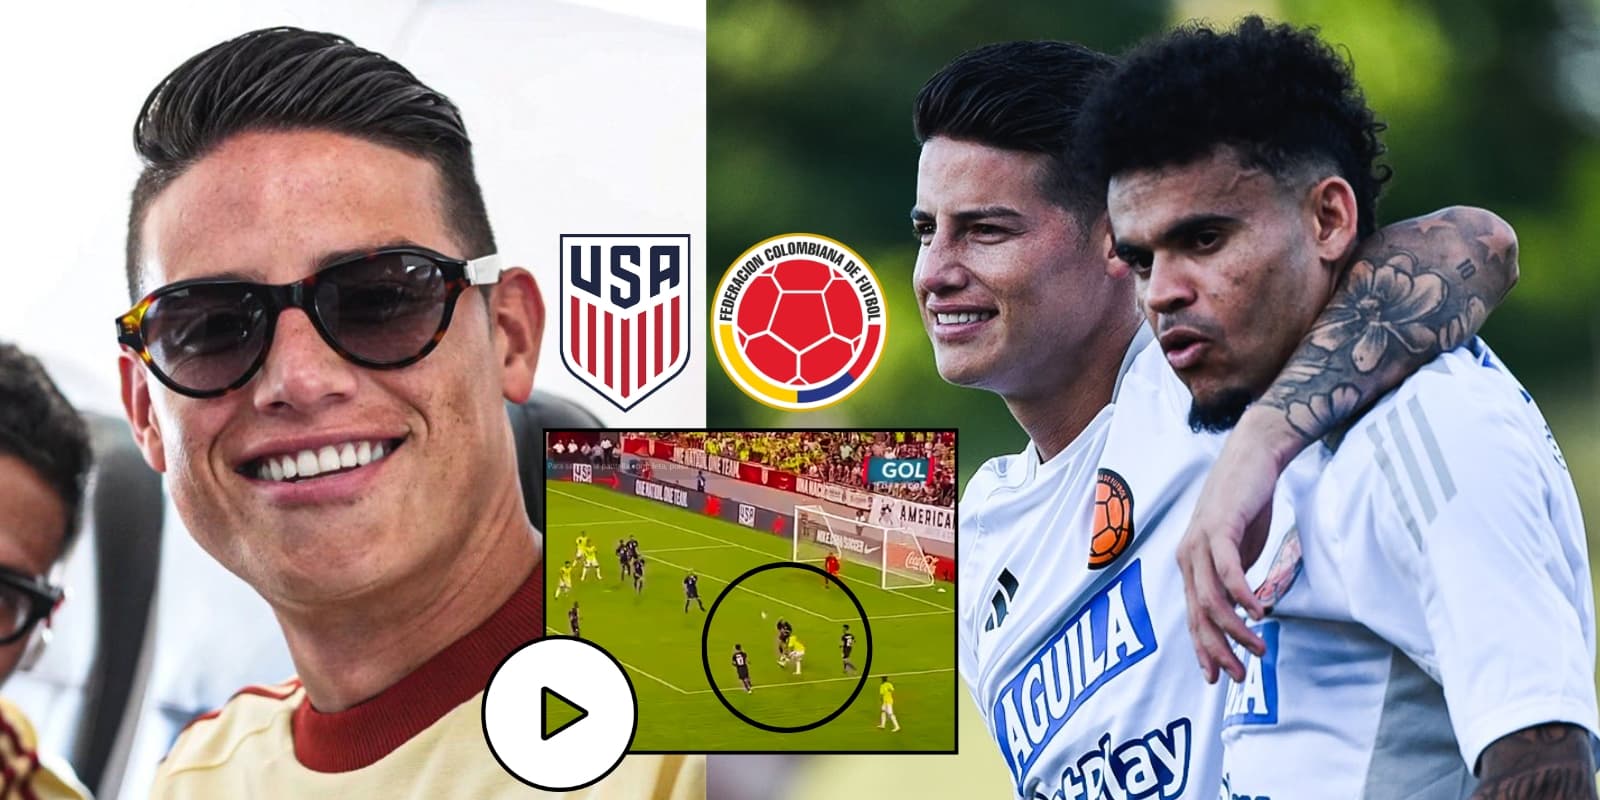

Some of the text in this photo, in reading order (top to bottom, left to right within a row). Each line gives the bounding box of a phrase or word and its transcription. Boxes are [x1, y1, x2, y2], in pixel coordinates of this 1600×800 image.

[882, 462, 926, 478] GOL
[1001, 580, 1144, 771] AGUILA
[1024, 718, 1191, 800] tPlay
